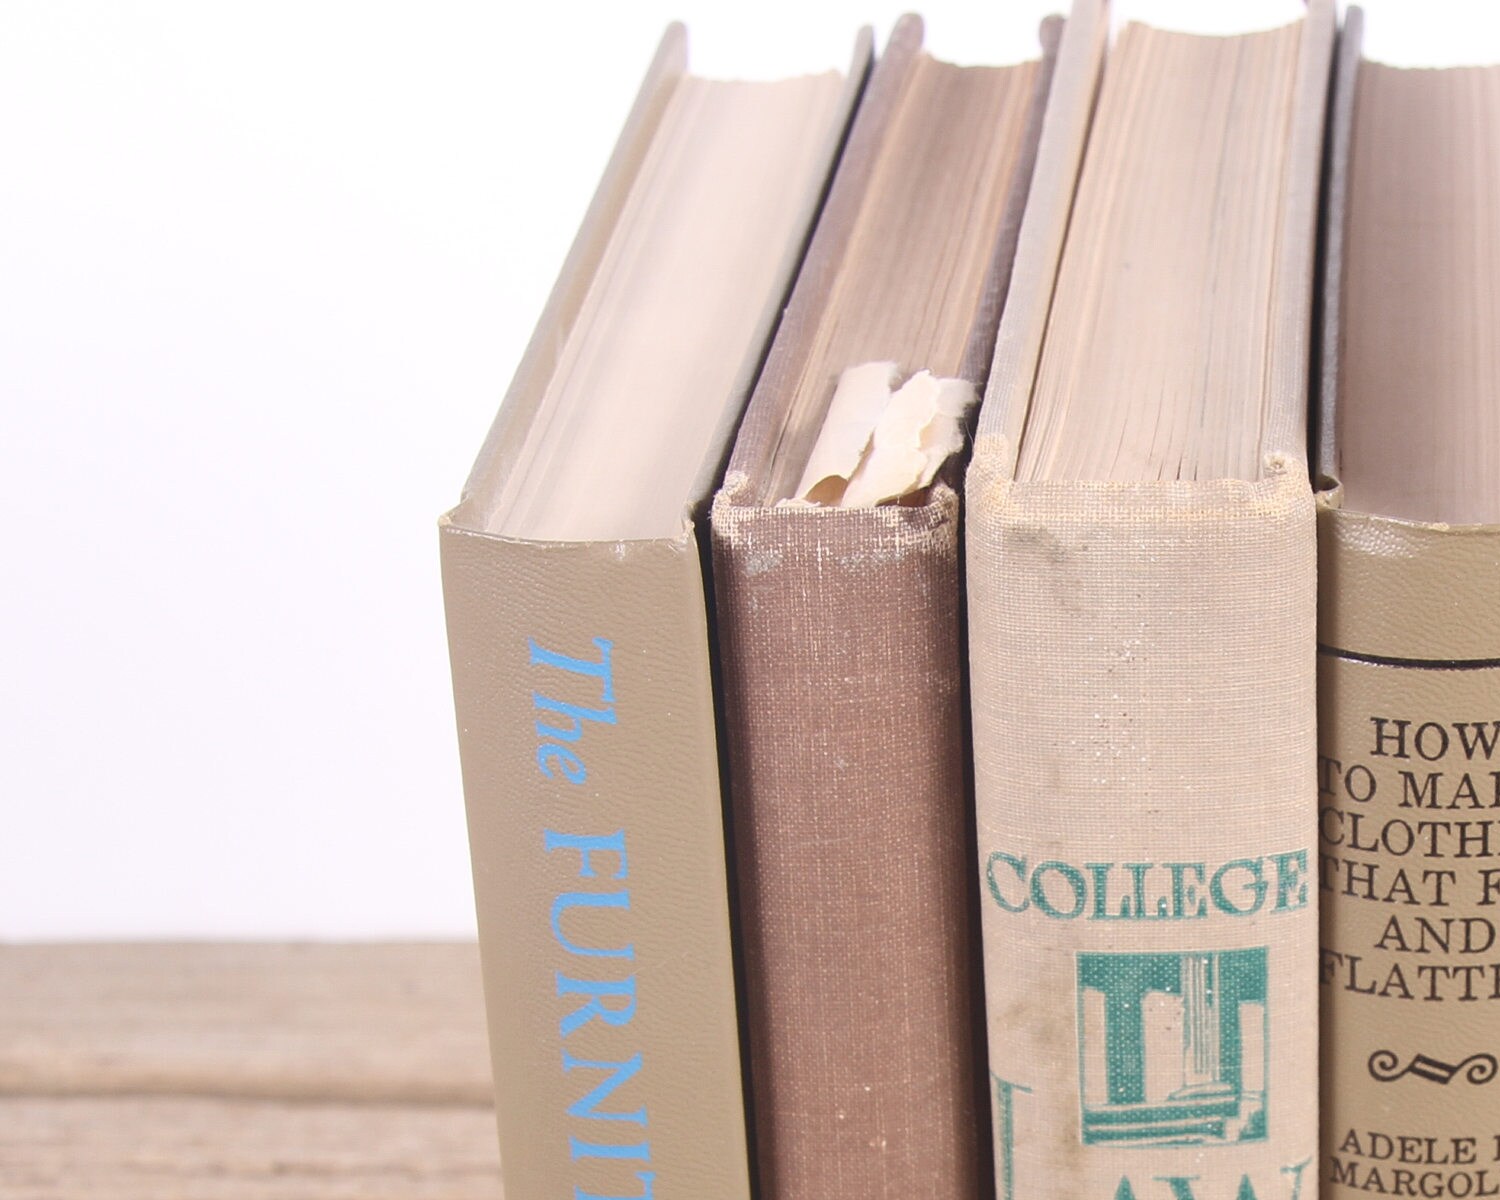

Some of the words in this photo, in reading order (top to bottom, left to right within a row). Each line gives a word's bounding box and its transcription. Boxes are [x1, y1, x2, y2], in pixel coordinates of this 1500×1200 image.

[528, 636, 618, 785] The
[1318, 755, 1377, 803] TO
[986, 848, 1310, 920] COLLEGE
[1318, 855, 1456, 907] THAT
[1373, 914, 1497, 955] AND
[1339, 1128, 1478, 1166] ADELE
